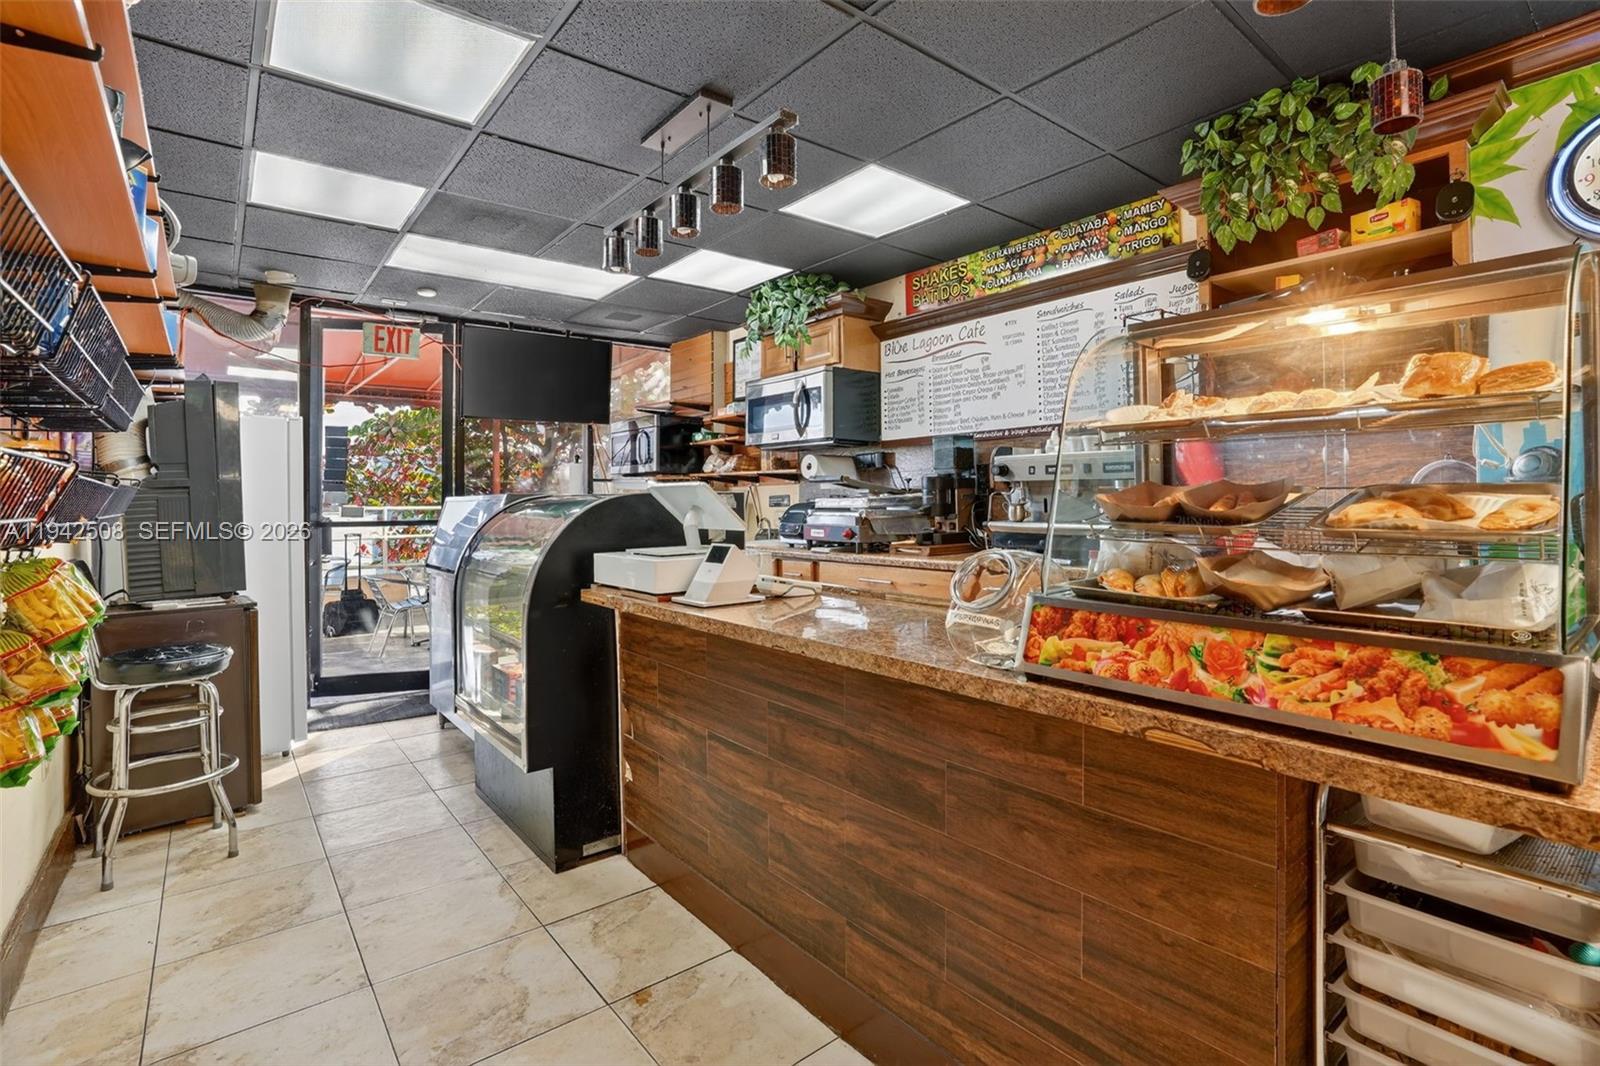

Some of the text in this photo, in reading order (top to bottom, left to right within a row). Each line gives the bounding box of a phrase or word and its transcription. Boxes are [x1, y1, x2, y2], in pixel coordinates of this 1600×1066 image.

[1585, 172, 1596, 187] 9
[1123, 198, 1165, 220] MAMEY
[1060, 216, 1110, 239] GUAYABA
[1123, 215, 1168, 237] MANGO
[984, 235, 1049, 263] STRAWBERRY
[1061, 235, 1100, 254] PAPAYA
[1125, 234, 1161, 252] TRIGO
[1062, 250, 1106, 270] BANANA
[911, 261, 969, 291] SHAKES
[1114, 285, 1145, 301] Salads
[1036, 301, 1085, 319] Sandwiches
[373, 325, 414, 355] EXIT
[911, 331, 954, 353] Lagoon
[958, 320, 986, 341] Cafe
